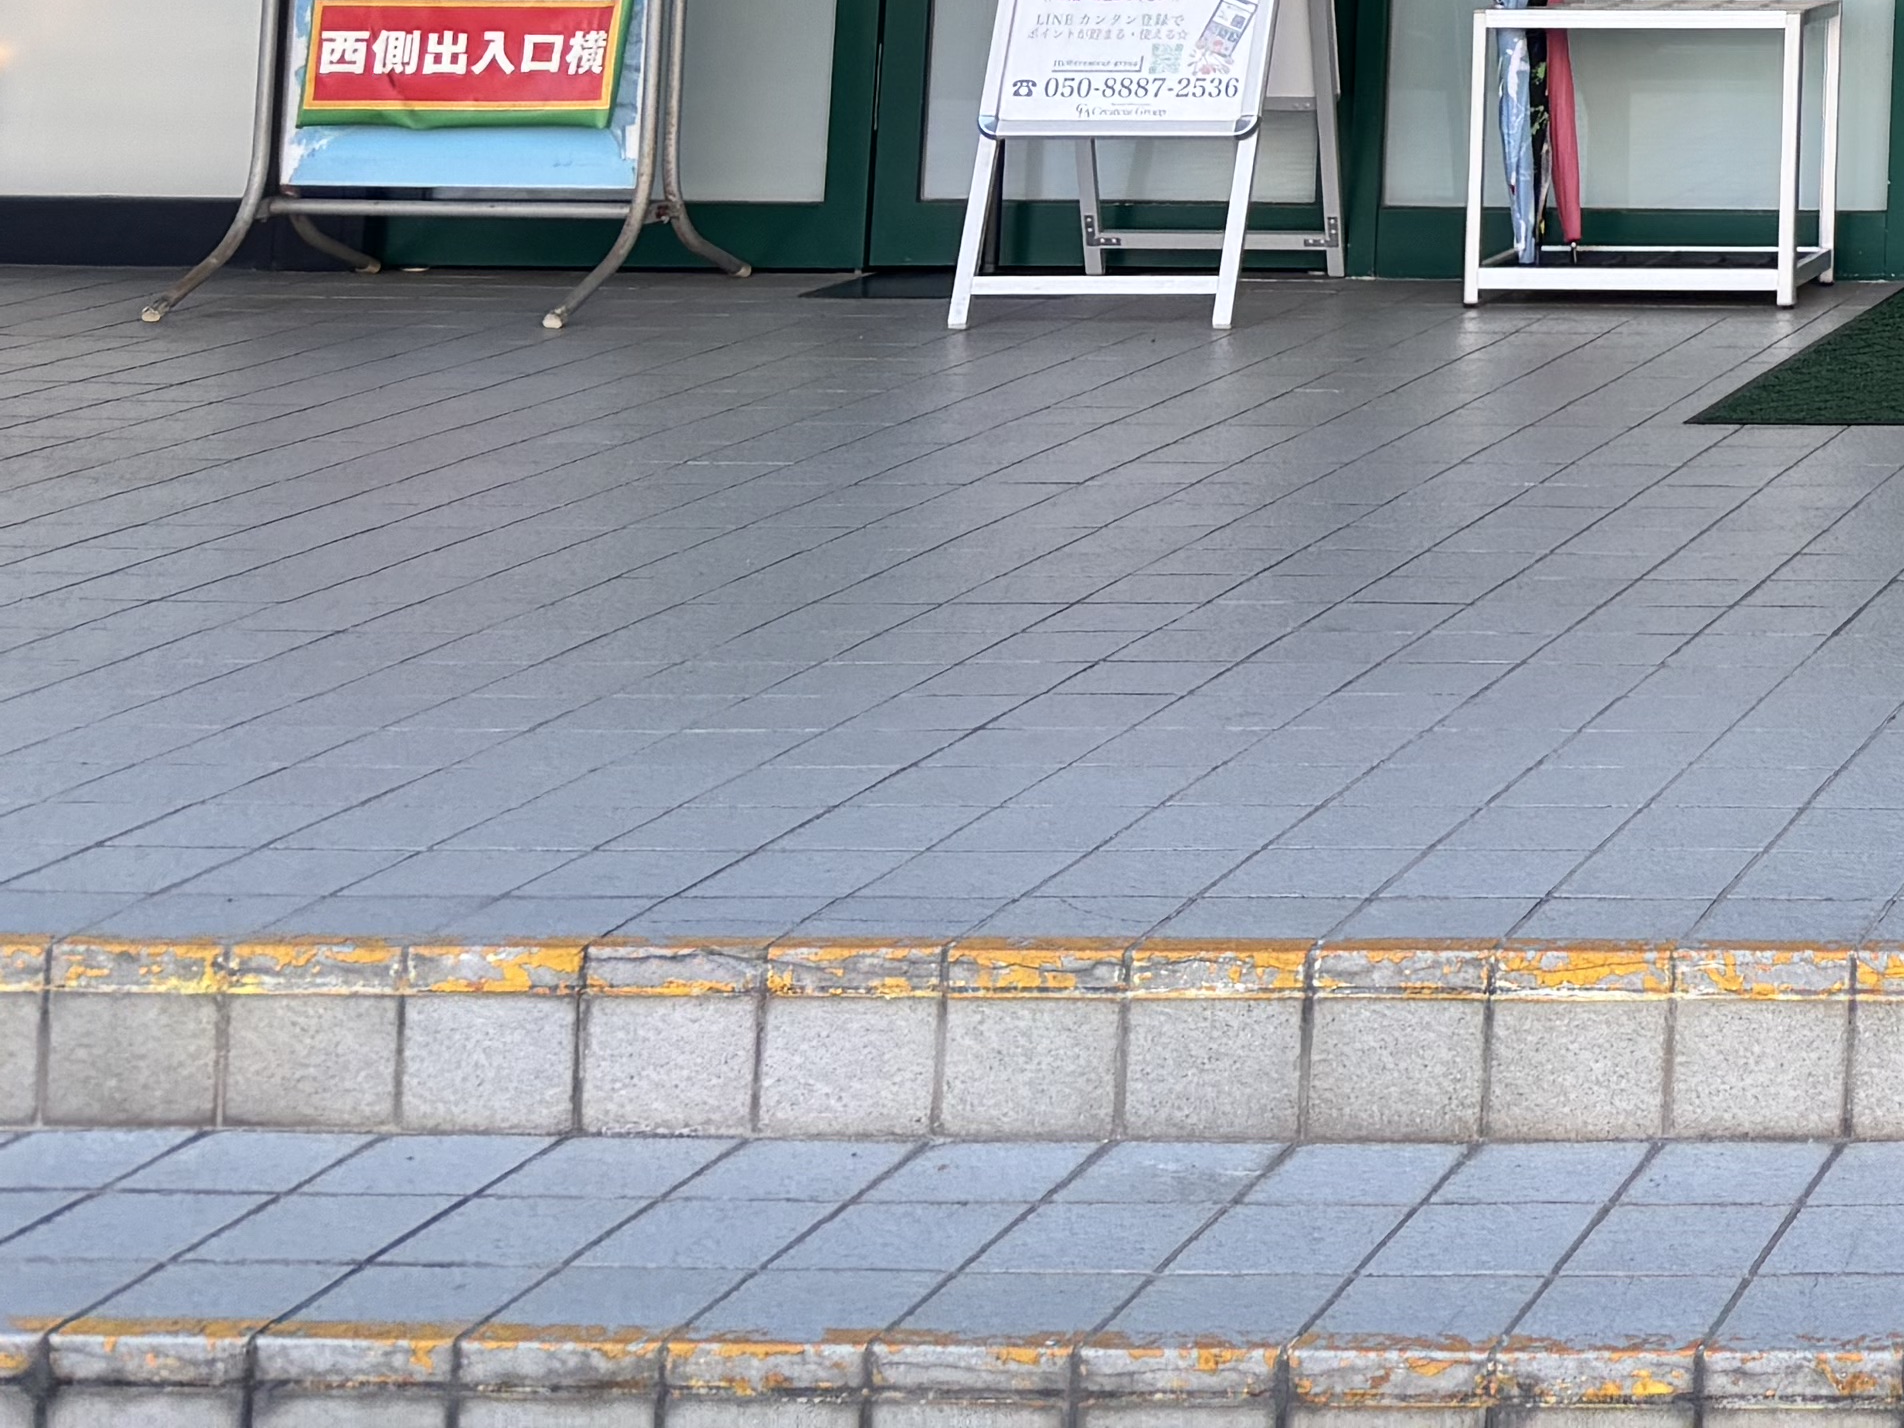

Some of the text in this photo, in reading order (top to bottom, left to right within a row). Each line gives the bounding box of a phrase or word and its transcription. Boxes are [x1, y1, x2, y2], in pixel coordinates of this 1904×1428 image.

[318, 29, 608, 76] 西側出入口横
[1044, 77, 1240, 99] 050-8887-2536
